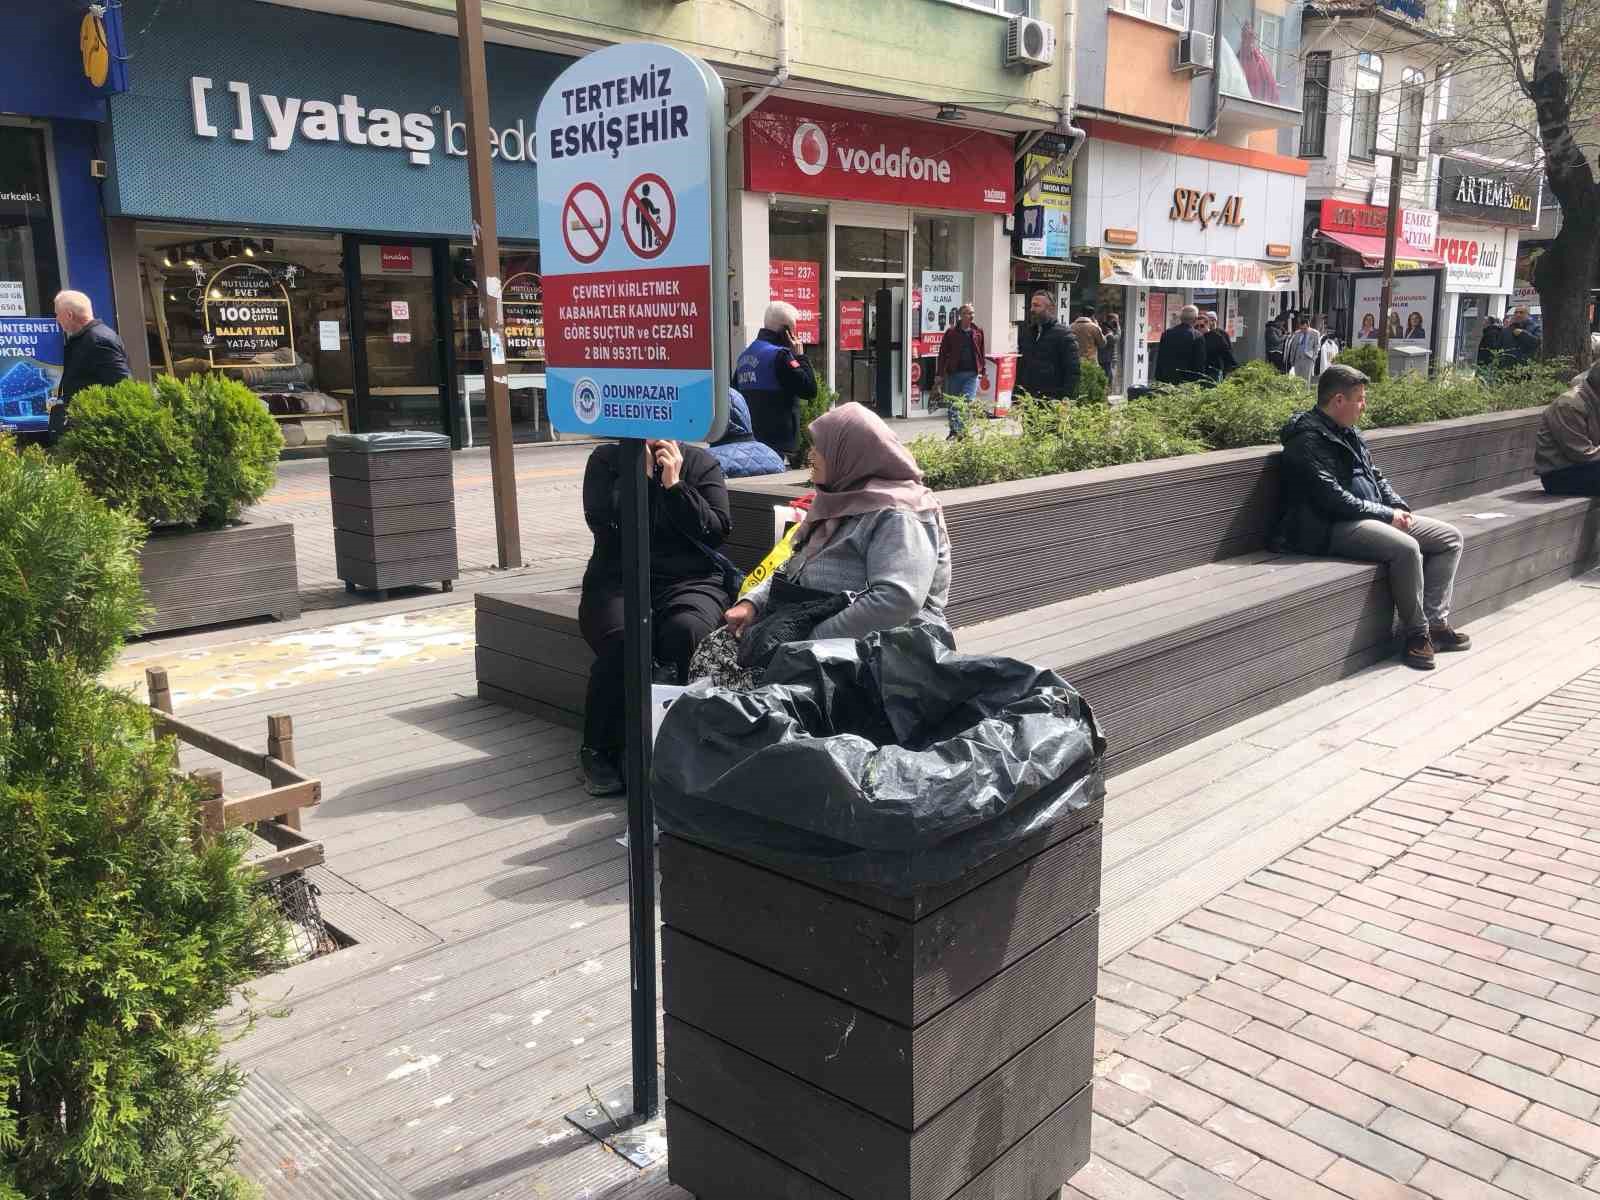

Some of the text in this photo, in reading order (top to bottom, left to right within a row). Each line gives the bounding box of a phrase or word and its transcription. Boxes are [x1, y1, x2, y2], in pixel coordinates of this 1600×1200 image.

[562, 64, 671, 116] TERTEMİZ
[260, 94, 436, 165] yataş
[551, 99, 688, 159] ESKİŞEHİR
[838, 144, 951, 183] vodafone
[235, 289, 258, 297] EVET
[573, 280, 680, 303] ÇEVREYİ KİRLETMEK
[220, 307, 250, 321] 100
[560, 302, 698, 320] KABAHATLER KANUNU'NA
[564, 322, 694, 343] GÖRE SUÇTUR ve CEZASI
[584, 343, 670, 361] 2 BİN 953TL'DİR.
[602, 384, 679, 401] ODUNPAZARI
[604, 402, 673, 420] BELEDİYESİ
